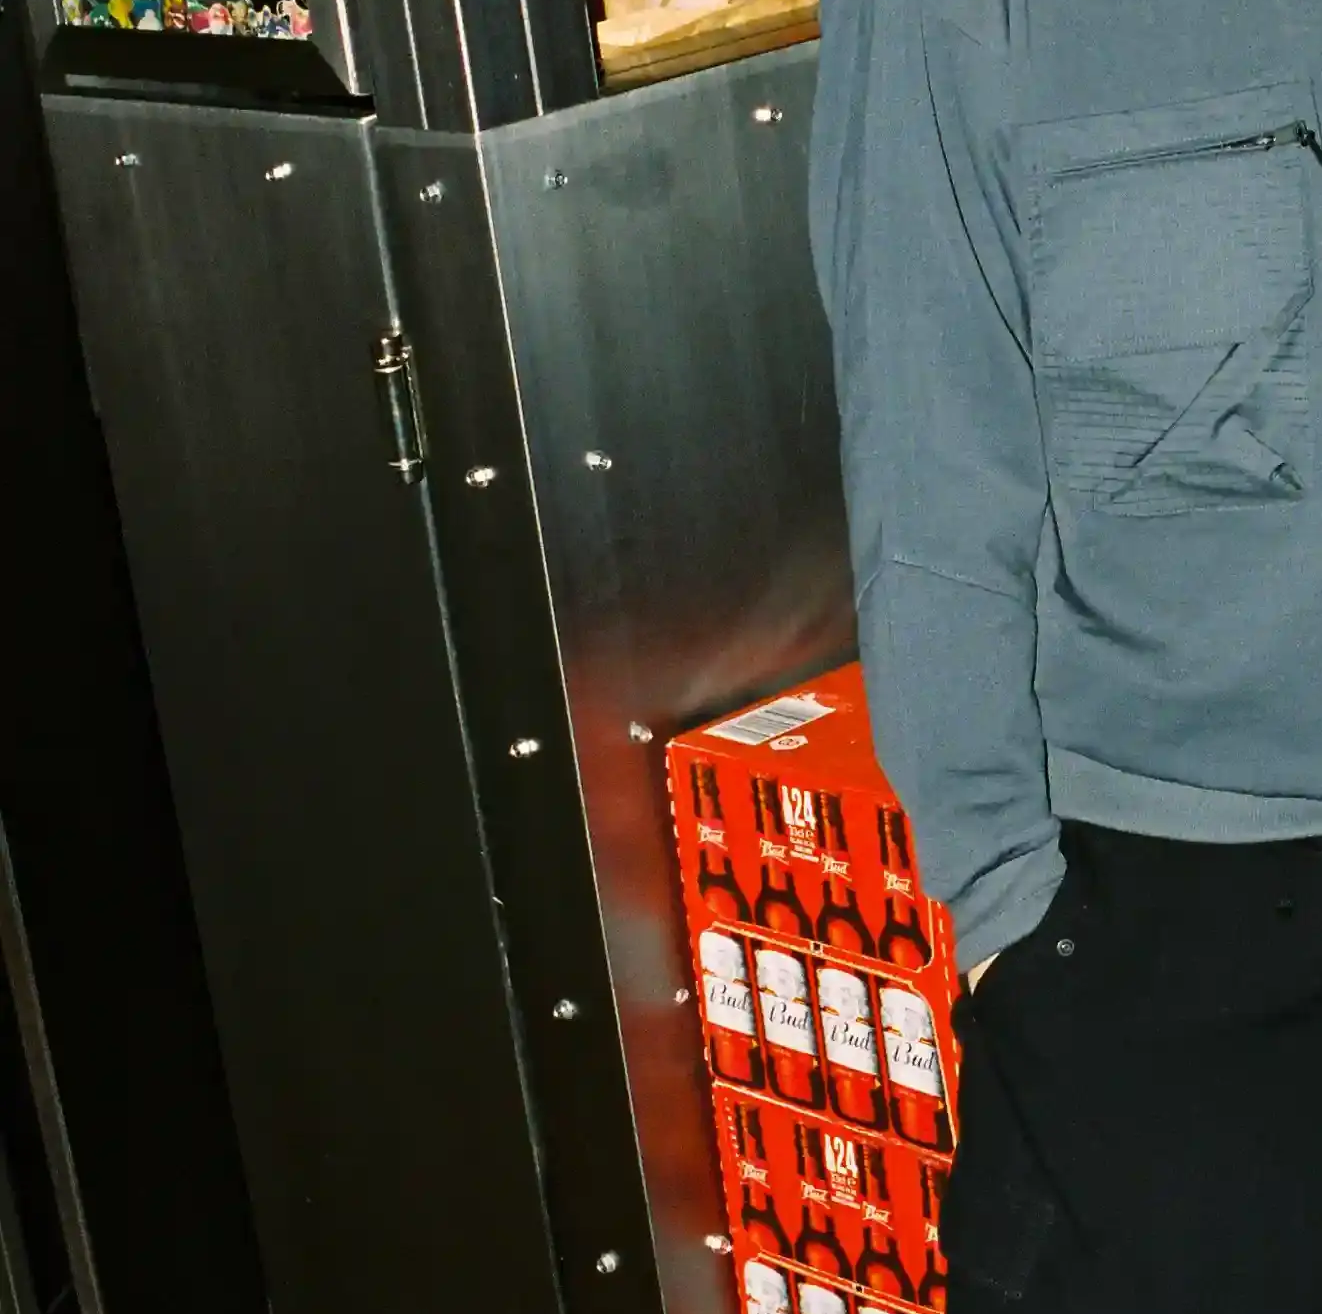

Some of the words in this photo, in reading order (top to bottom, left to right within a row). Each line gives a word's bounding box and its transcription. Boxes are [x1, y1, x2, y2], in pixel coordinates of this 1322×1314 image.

[709, 984, 752, 1013] Bud
[768, 1000, 809, 1031] Bud
[831, 1019, 872, 1052] Bud
[893, 1041, 936, 1073] Bud
